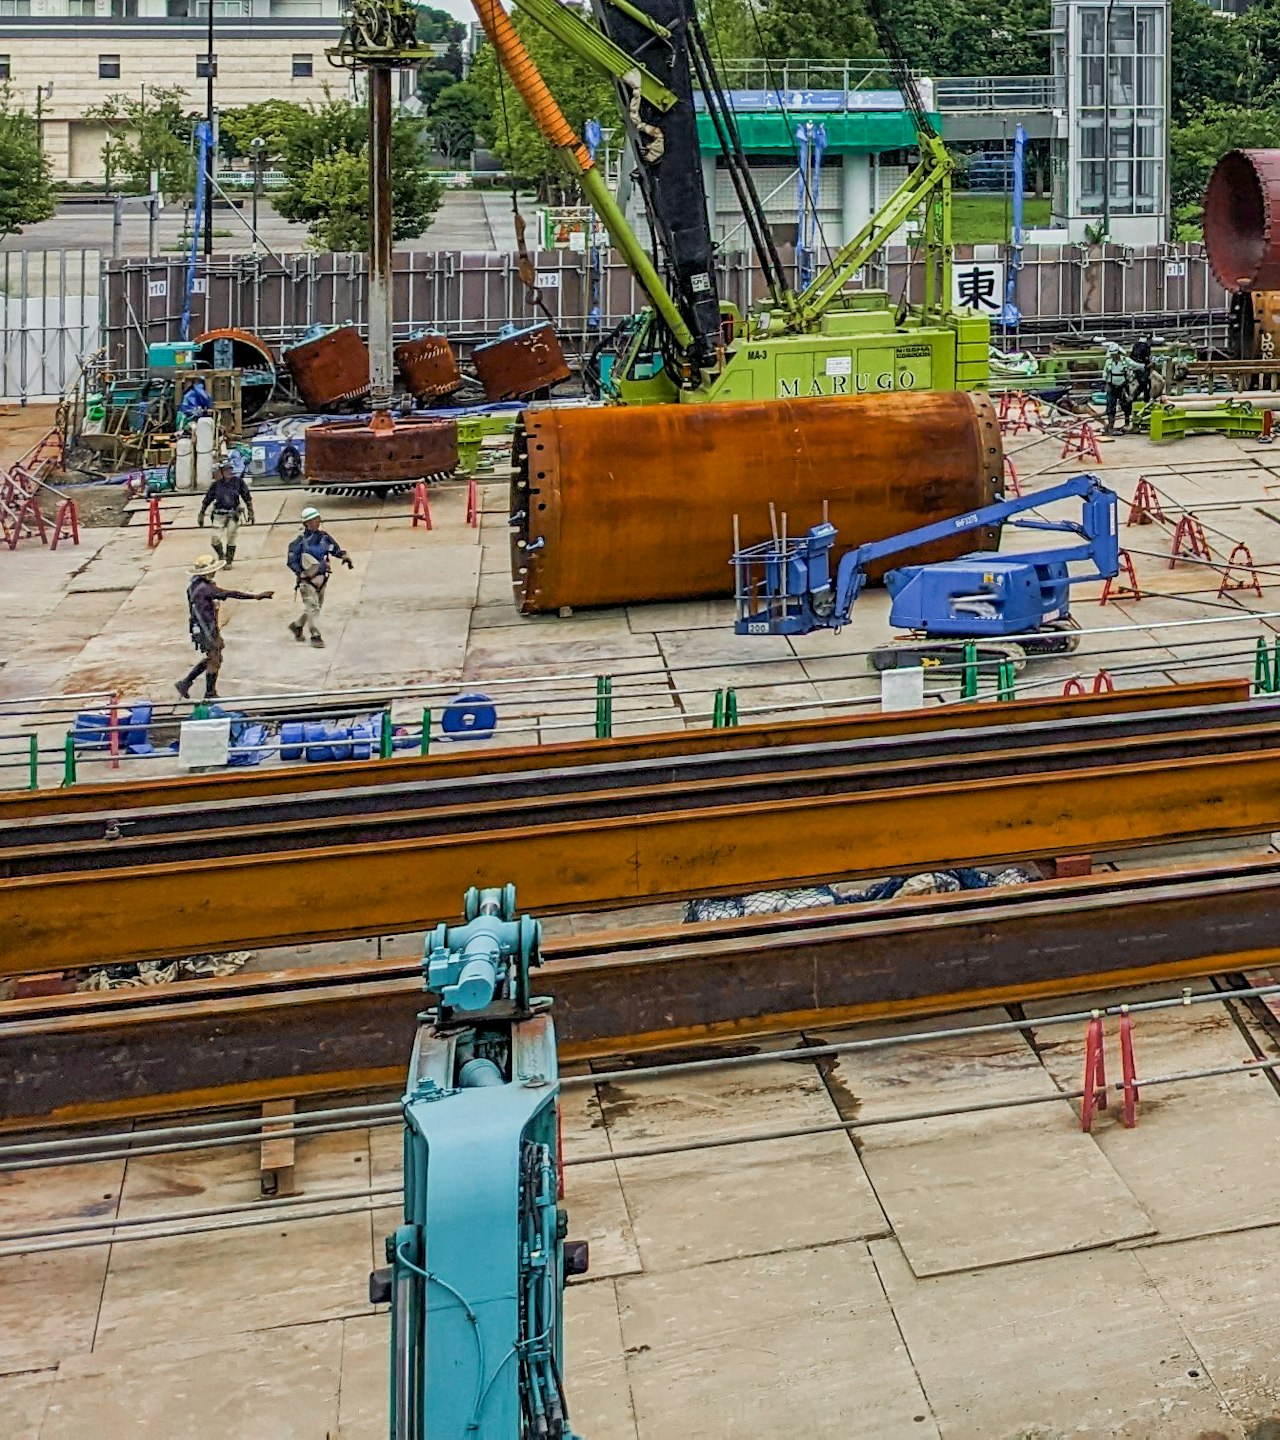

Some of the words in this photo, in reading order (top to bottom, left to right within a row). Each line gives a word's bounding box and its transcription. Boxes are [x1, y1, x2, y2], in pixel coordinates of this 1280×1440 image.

[957, 266, 1001, 311] 東
[747, 349, 768, 361] MA-3
[778, 369, 916, 398] MARUGO
[749, 623, 766, 633] 200
